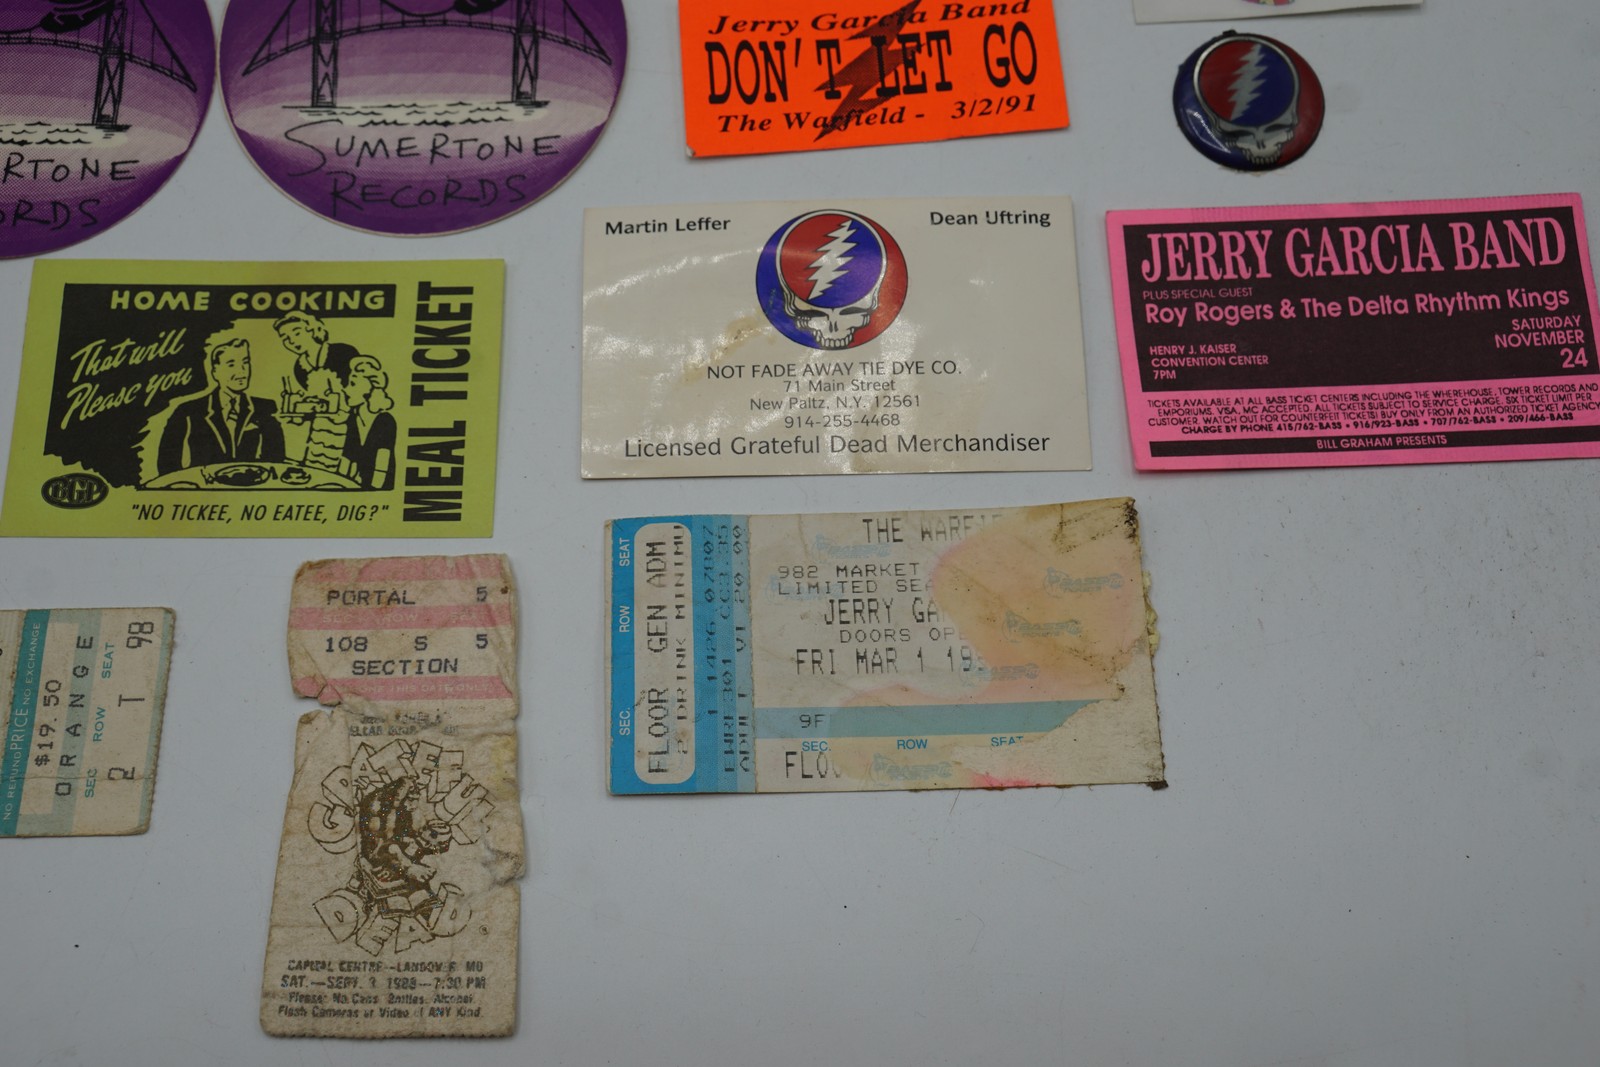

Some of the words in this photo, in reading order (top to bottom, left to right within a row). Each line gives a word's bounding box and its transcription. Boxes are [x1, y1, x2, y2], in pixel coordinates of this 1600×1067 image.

[708, 15, 799, 36] Jerry
[811, 10, 928, 32] Garcia
[940, 0, 1032, 21] Band
[705, 38, 842, 104] DON'T
[870, 30, 953, 97] LET
[983, 21, 1038, 88] GO
[717, 114, 772, 133] The
[783, 107, 905, 132] Warfield
[951, 94, 1037, 120] 3/2/91
[284, 119, 563, 177] SUMERTONE
[326, 170, 528, 209] RECORDS
[605, 219, 669, 236] Martin
[675, 216, 732, 233] Leffer
[930, 211, 979, 227] Dean
[985, 210, 1051, 229] Uftring
[1141, 230, 1273, 283] JERRY
[1284, 223, 1444, 279] GARCIA
[1448, 217, 1566, 270] BAND
[111, 290, 210, 311] HOME
[229, 289, 386, 312] COOKING
[1142, 291, 1169, 300] PLUS
[1171, 289, 1216, 300] SPECIAL
[1218, 287, 1253, 298] GUEST
[1145, 303, 1188, 327] Roy
[1195, 301, 1273, 326] Rogers
[1280, 298, 1296, 319] &
[1301, 298, 1342, 318] The
[1348, 295, 1409, 316] Delta
[1415, 291, 1500, 317] Rhythm
[1506, 288, 1570, 312] Kings
[1511, 315, 1581, 331] SATURDAY
[409, 280, 475, 407] TICKET
[1149, 345, 1185, 356] HENRY
[1188, 345, 1197, 355] J.
[1199, 343, 1237, 355] KAISER
[1495, 329, 1585, 348] NOVEMBER
[70, 337, 130, 383] That
[128, 327, 188, 362] will
[1151, 356, 1226, 368] CONVENTION
[1228, 355, 1269, 366] CENTER
[1560, 347, 1589, 368] 24
[706, 363, 745, 380] NOT
[751, 363, 797, 379] FADE
[802, 362, 854, 377] AWAY
[858, 361, 887, 377] TIE
[892, 360, 926, 376] DYE
[931, 359, 963, 375] CO.
[1153, 370, 1176, 380] 7PM
[783, 380, 801, 392] 71
[808, 379, 847, 392] Main
[850, 378, 896, 391] Street
[1149, 399, 1181, 408] TICKETS
[1183, 397, 1231, 408] AVAILABLE
[1234, 397, 1244, 406] AT
[1247, 396, 1262, 405] ALL
[1265, 395, 1287, 404] BASS
[1289, 394, 1317, 404] TICKET
[1320, 393, 1359, 403] CENTERS
[1362, 391, 1412, 401] INCLUDING
[1415, 390, 1430, 400] THE
[1498, 386, 1530, 396] TOWER
[1532, 384, 1577, 394] RECORDS
[1579, 383, 1599, 392] AND
[60, 381, 137, 430] Please
[145, 366, 193, 407] you
[750, 398, 783, 411] New
[836, 395, 867, 409] N.Y.
[874, 394, 921, 408] 12561
[1243, 405, 1260, 414] MC
[1315, 402, 1331, 412] ALL
[1333, 401, 1365, 411] TICKETS
[1367, 400, 1406, 410] SUBJECT
[1408, 400, 1419, 409] TO
[1422, 398, 1459, 408] SERVICE
[1506, 395, 1519, 404] SIX
[1521, 394, 1550, 404] TICKET
[1551, 393, 1574, 402] LIMIT
[1575, 392, 1592, 401] PER
[784, 413, 900, 429] 914-255-4468
[1181, 425, 1223, 435] CHARGE
[1225, 424, 1238, 433] BY
[1240, 422, 1274, 432] PHONE
[1276, 420, 1342, 432] 415/762-BASS
[1353, 417, 1420, 429] 916/923-BASS
[1431, 415, 1497, 426] 707/762-BASS
[1508, 412, 1574, 423] 209/466-BASS
[1203, 415, 1237, 425] WATCH
[1239, 414, 1258, 424] OUT
[1260, 413, 1279, 423] FOR
[1281, 411, 1340, 422] COUNTERFEIT
[1381, 409, 1398, 419] BUY
[1400, 408, 1425, 418] ONLY
[1427, 407, 1454, 417] FROM
[1456, 406, 1470, 416] AN
[1473, 404, 1528, 415] AUTHORIZED
[1530, 402, 1559, 413] TICKET
[624, 437, 721, 458] Licensed
[730, 434, 821, 456] Grateful
[830, 434, 888, 454] Dead
[898, 433, 1051, 454] Merchandiser
[1317, 438, 1338, 449] BILL
[1340, 436, 1393, 449] GRAHAM
[1395, 434, 1448, 446] PRESENTS
[402, 419, 467, 523] MEAL
[131, 504, 164, 521] "NO
[170, 504, 232, 523] TICKEE,
[240, 504, 267, 521] NO
[271, 504, 328, 523] EATEE,
[336, 503, 390, 522] DIG?"
[862, 518, 903, 543] THE
[619, 538, 630, 567] SEAT
[646, 541, 666, 588] ADM
[778, 565, 818, 579] 982
[836, 562, 919, 578] MARKET
[327, 589, 416, 606] PORTAL
[476, 586, 488, 603] 5
[778, 580, 877, 595] LIMITED
[619, 605, 630, 633] ROW
[824, 597, 893, 625] JERRY
[126, 621, 154, 649] 98
[647, 605, 668, 653] GEN
[839, 628, 911, 644] DOORS
[26, 622, 40, 684] EXCHANGE
[325, 636, 368, 653] 108
[476, 633, 488, 650] 5
[352, 657, 458, 676] SECTION
[796, 648, 836, 675] FRI
[856, 647, 899, 675] MAR
[917, 647, 924, 672] 1
[675, 638, 688, 720] DRINK
[23, 688, 32, 705] NO
[118, 694, 146, 707] T
[10, 708, 29, 751] PRICE
[34, 679, 62, 767] $19.50
[84, 768, 97, 799] SEC
[93, 707, 106, 742] ROW
[101, 642, 115, 679] SEAT
[619, 707, 631, 736] SEC.
[648, 688, 669, 773] FLOOR
[801, 740, 832, 752] SEC.
[896, 739, 928, 750] ROW
[8, 752, 21, 798] REFUND
[107, 766, 135, 781] 2
[3, 802, 13, 821] NO
[379, 1006, 410, 1018] Video
